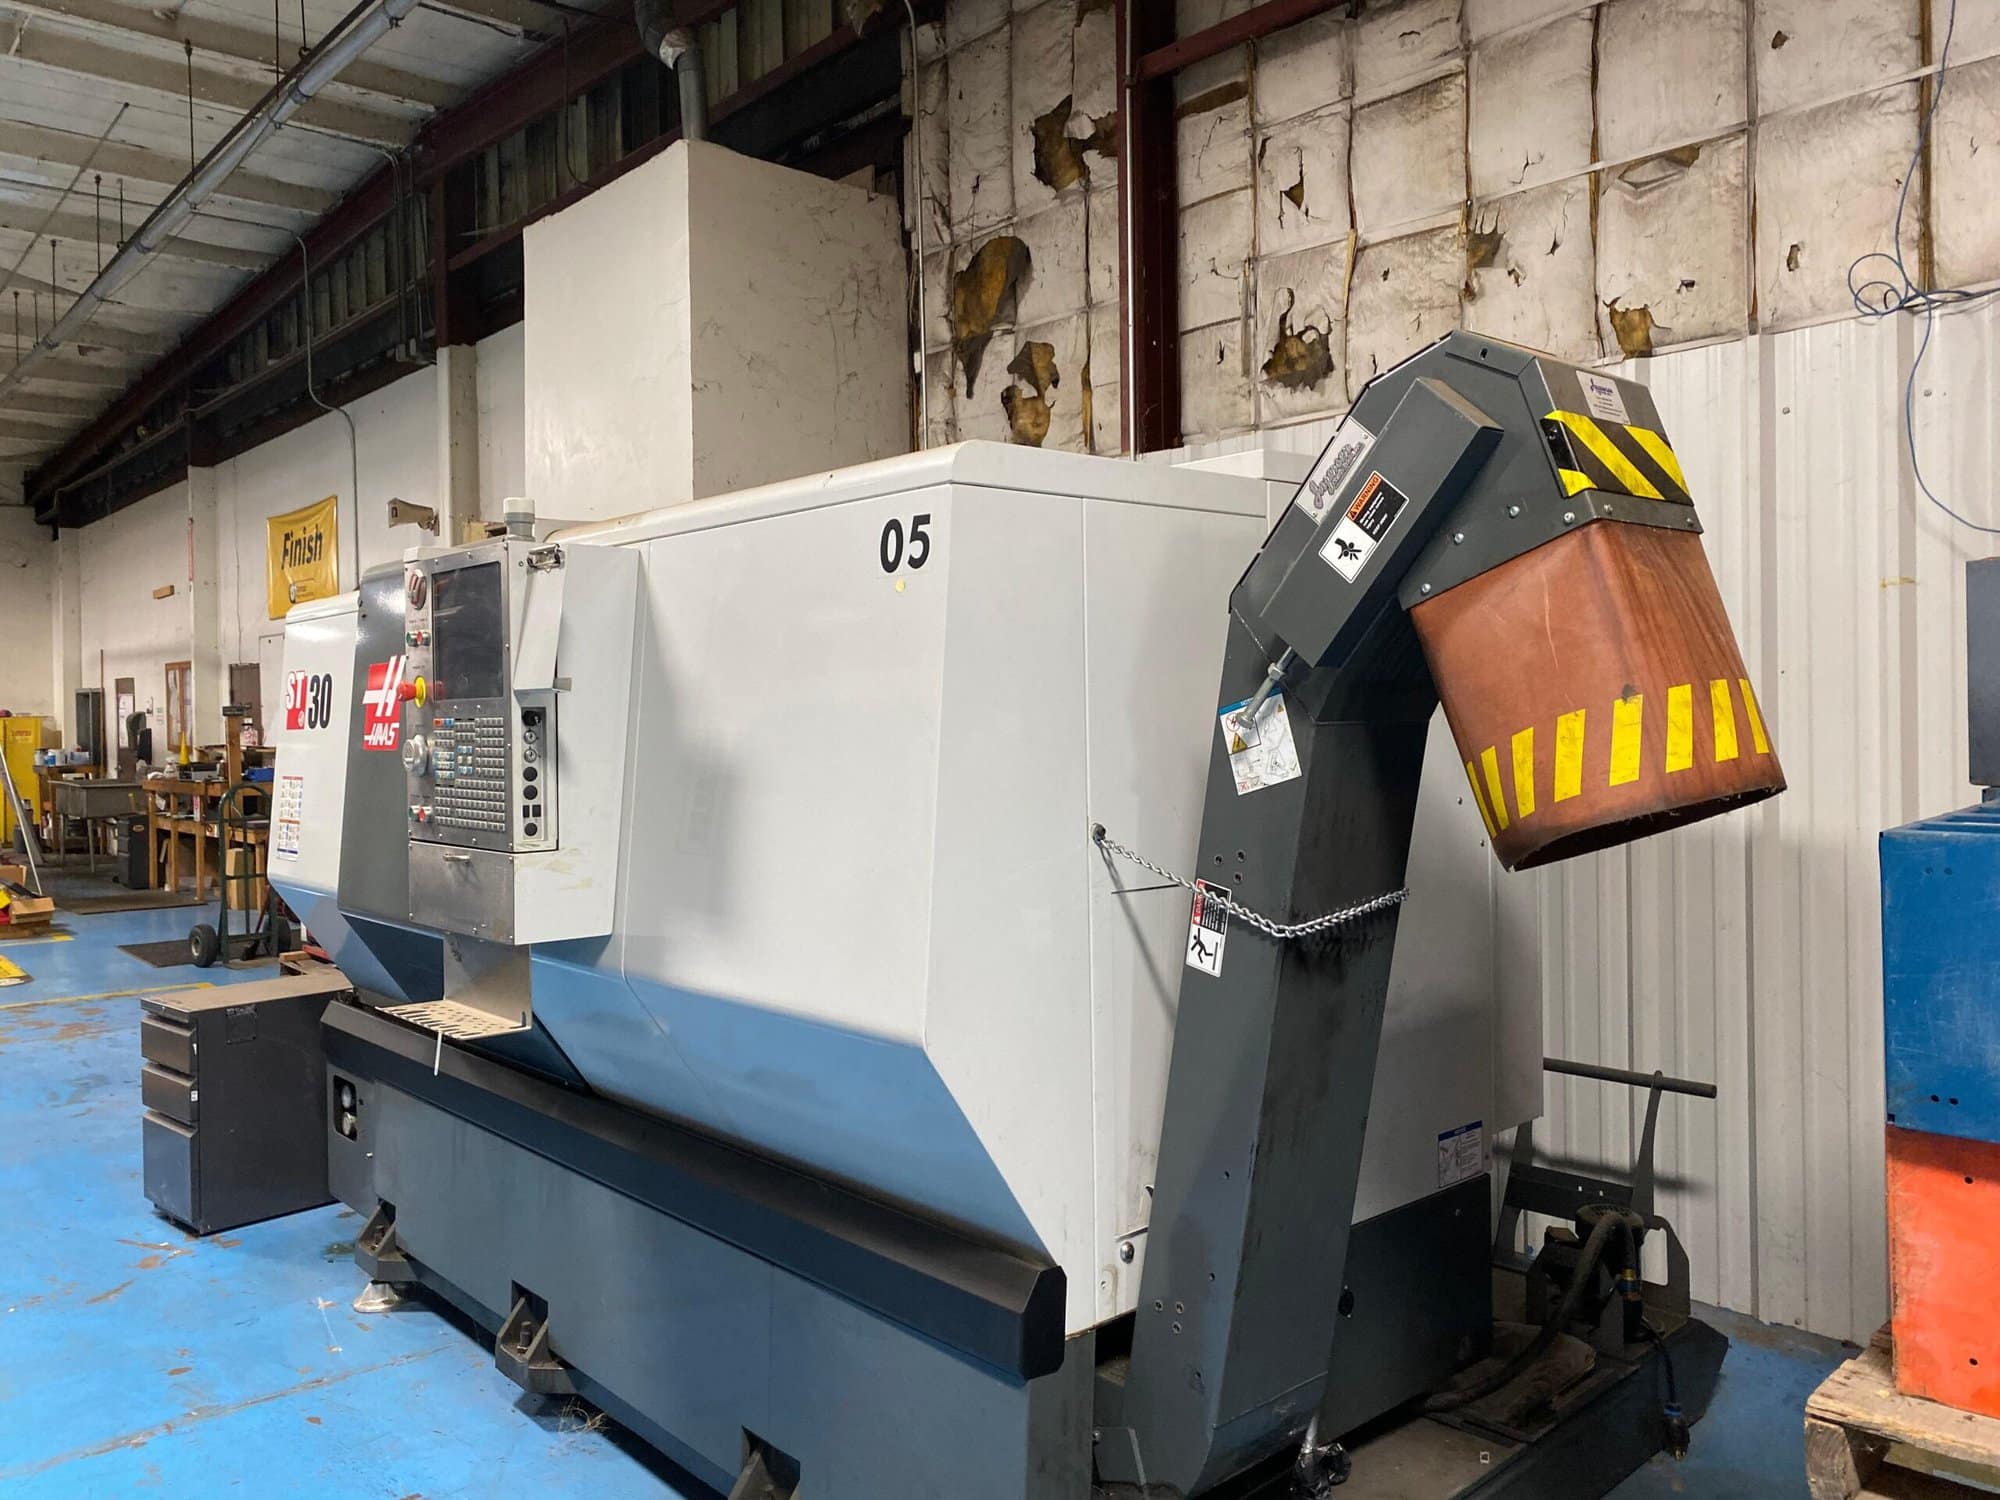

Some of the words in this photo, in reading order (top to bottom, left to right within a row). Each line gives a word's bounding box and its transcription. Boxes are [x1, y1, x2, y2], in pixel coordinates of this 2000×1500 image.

[1354, 475, 1379, 511] WARNING
[281, 524, 323, 570] Finish
[880, 513, 931, 573] 05
[286, 670, 305, 710] ST
[308, 673, 332, 729] 30
[364, 723, 400, 746] HAAS
